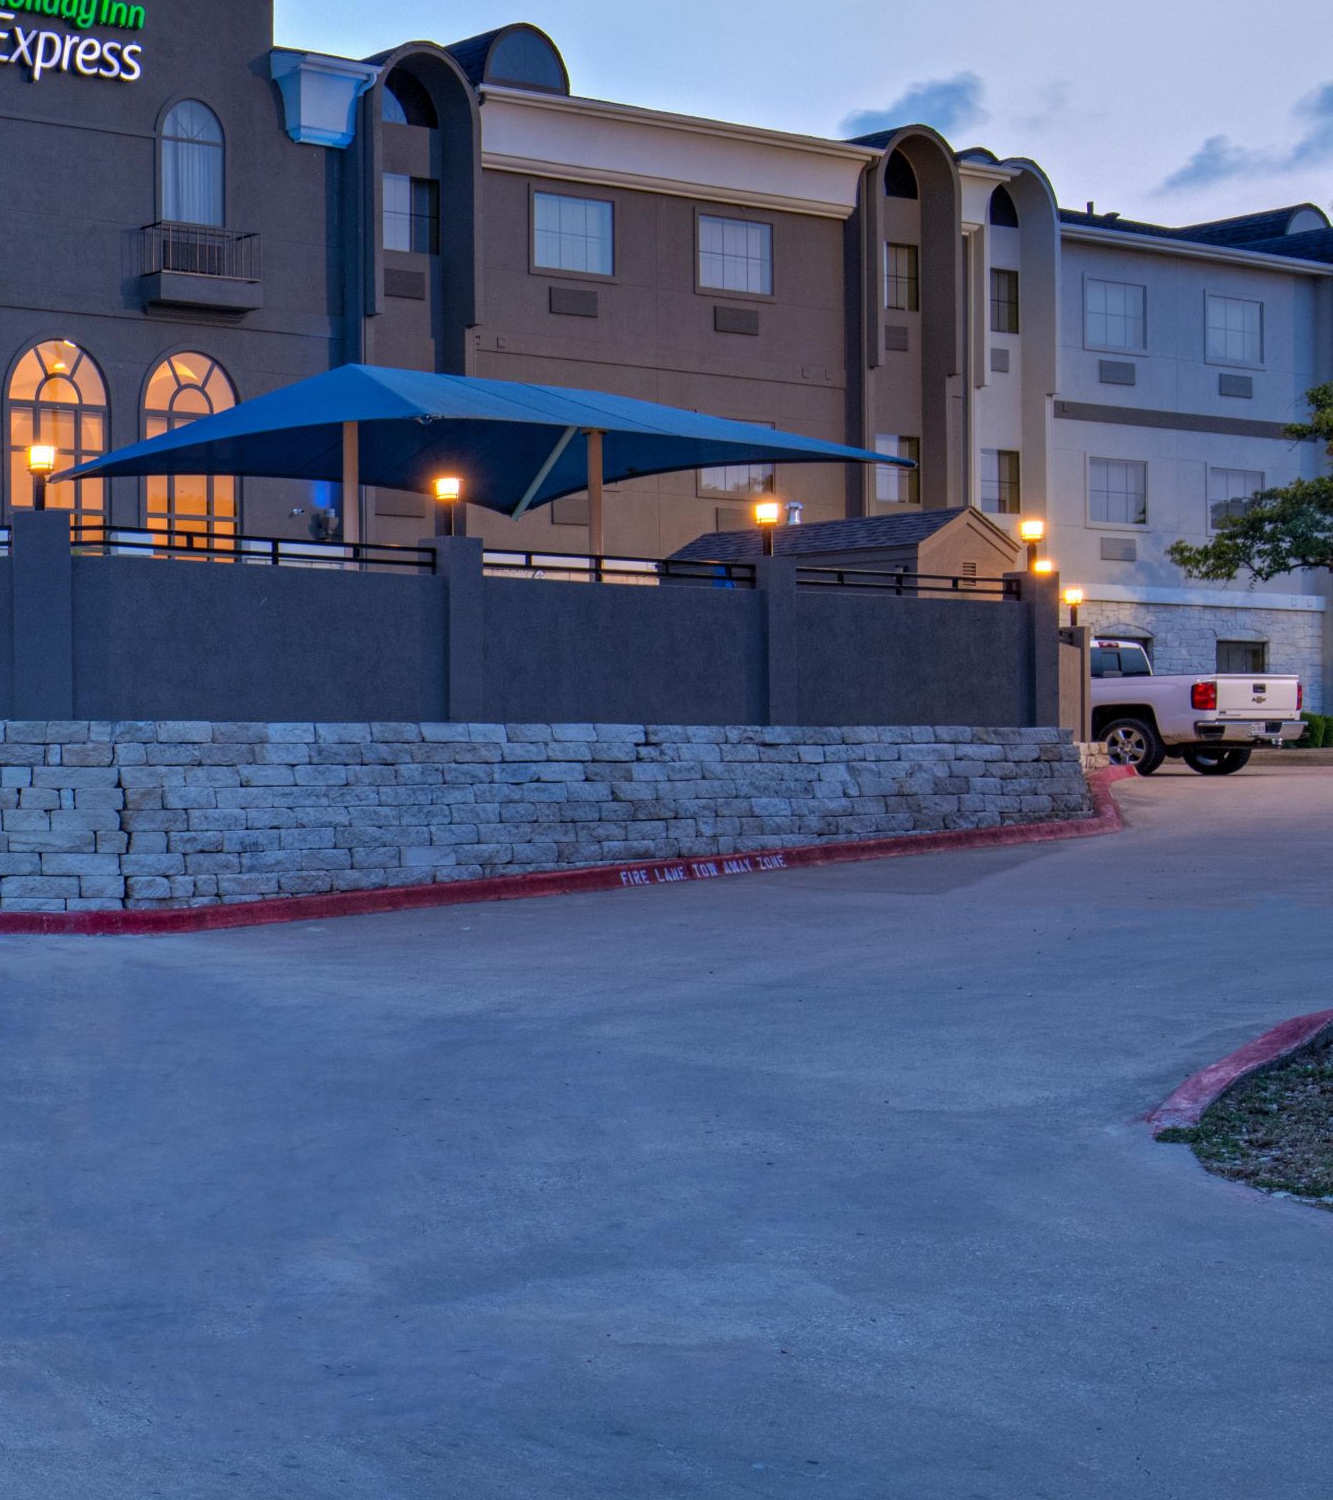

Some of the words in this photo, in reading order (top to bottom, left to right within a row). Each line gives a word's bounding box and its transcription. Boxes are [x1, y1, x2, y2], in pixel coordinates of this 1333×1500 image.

[620, 869, 650, 885] FIRE
[654, 866, 686, 882] LANE
[692, 862, 718, 878] TOW
[723, 858, 753, 874] AWAY
[757, 854, 787, 870] ZONE
